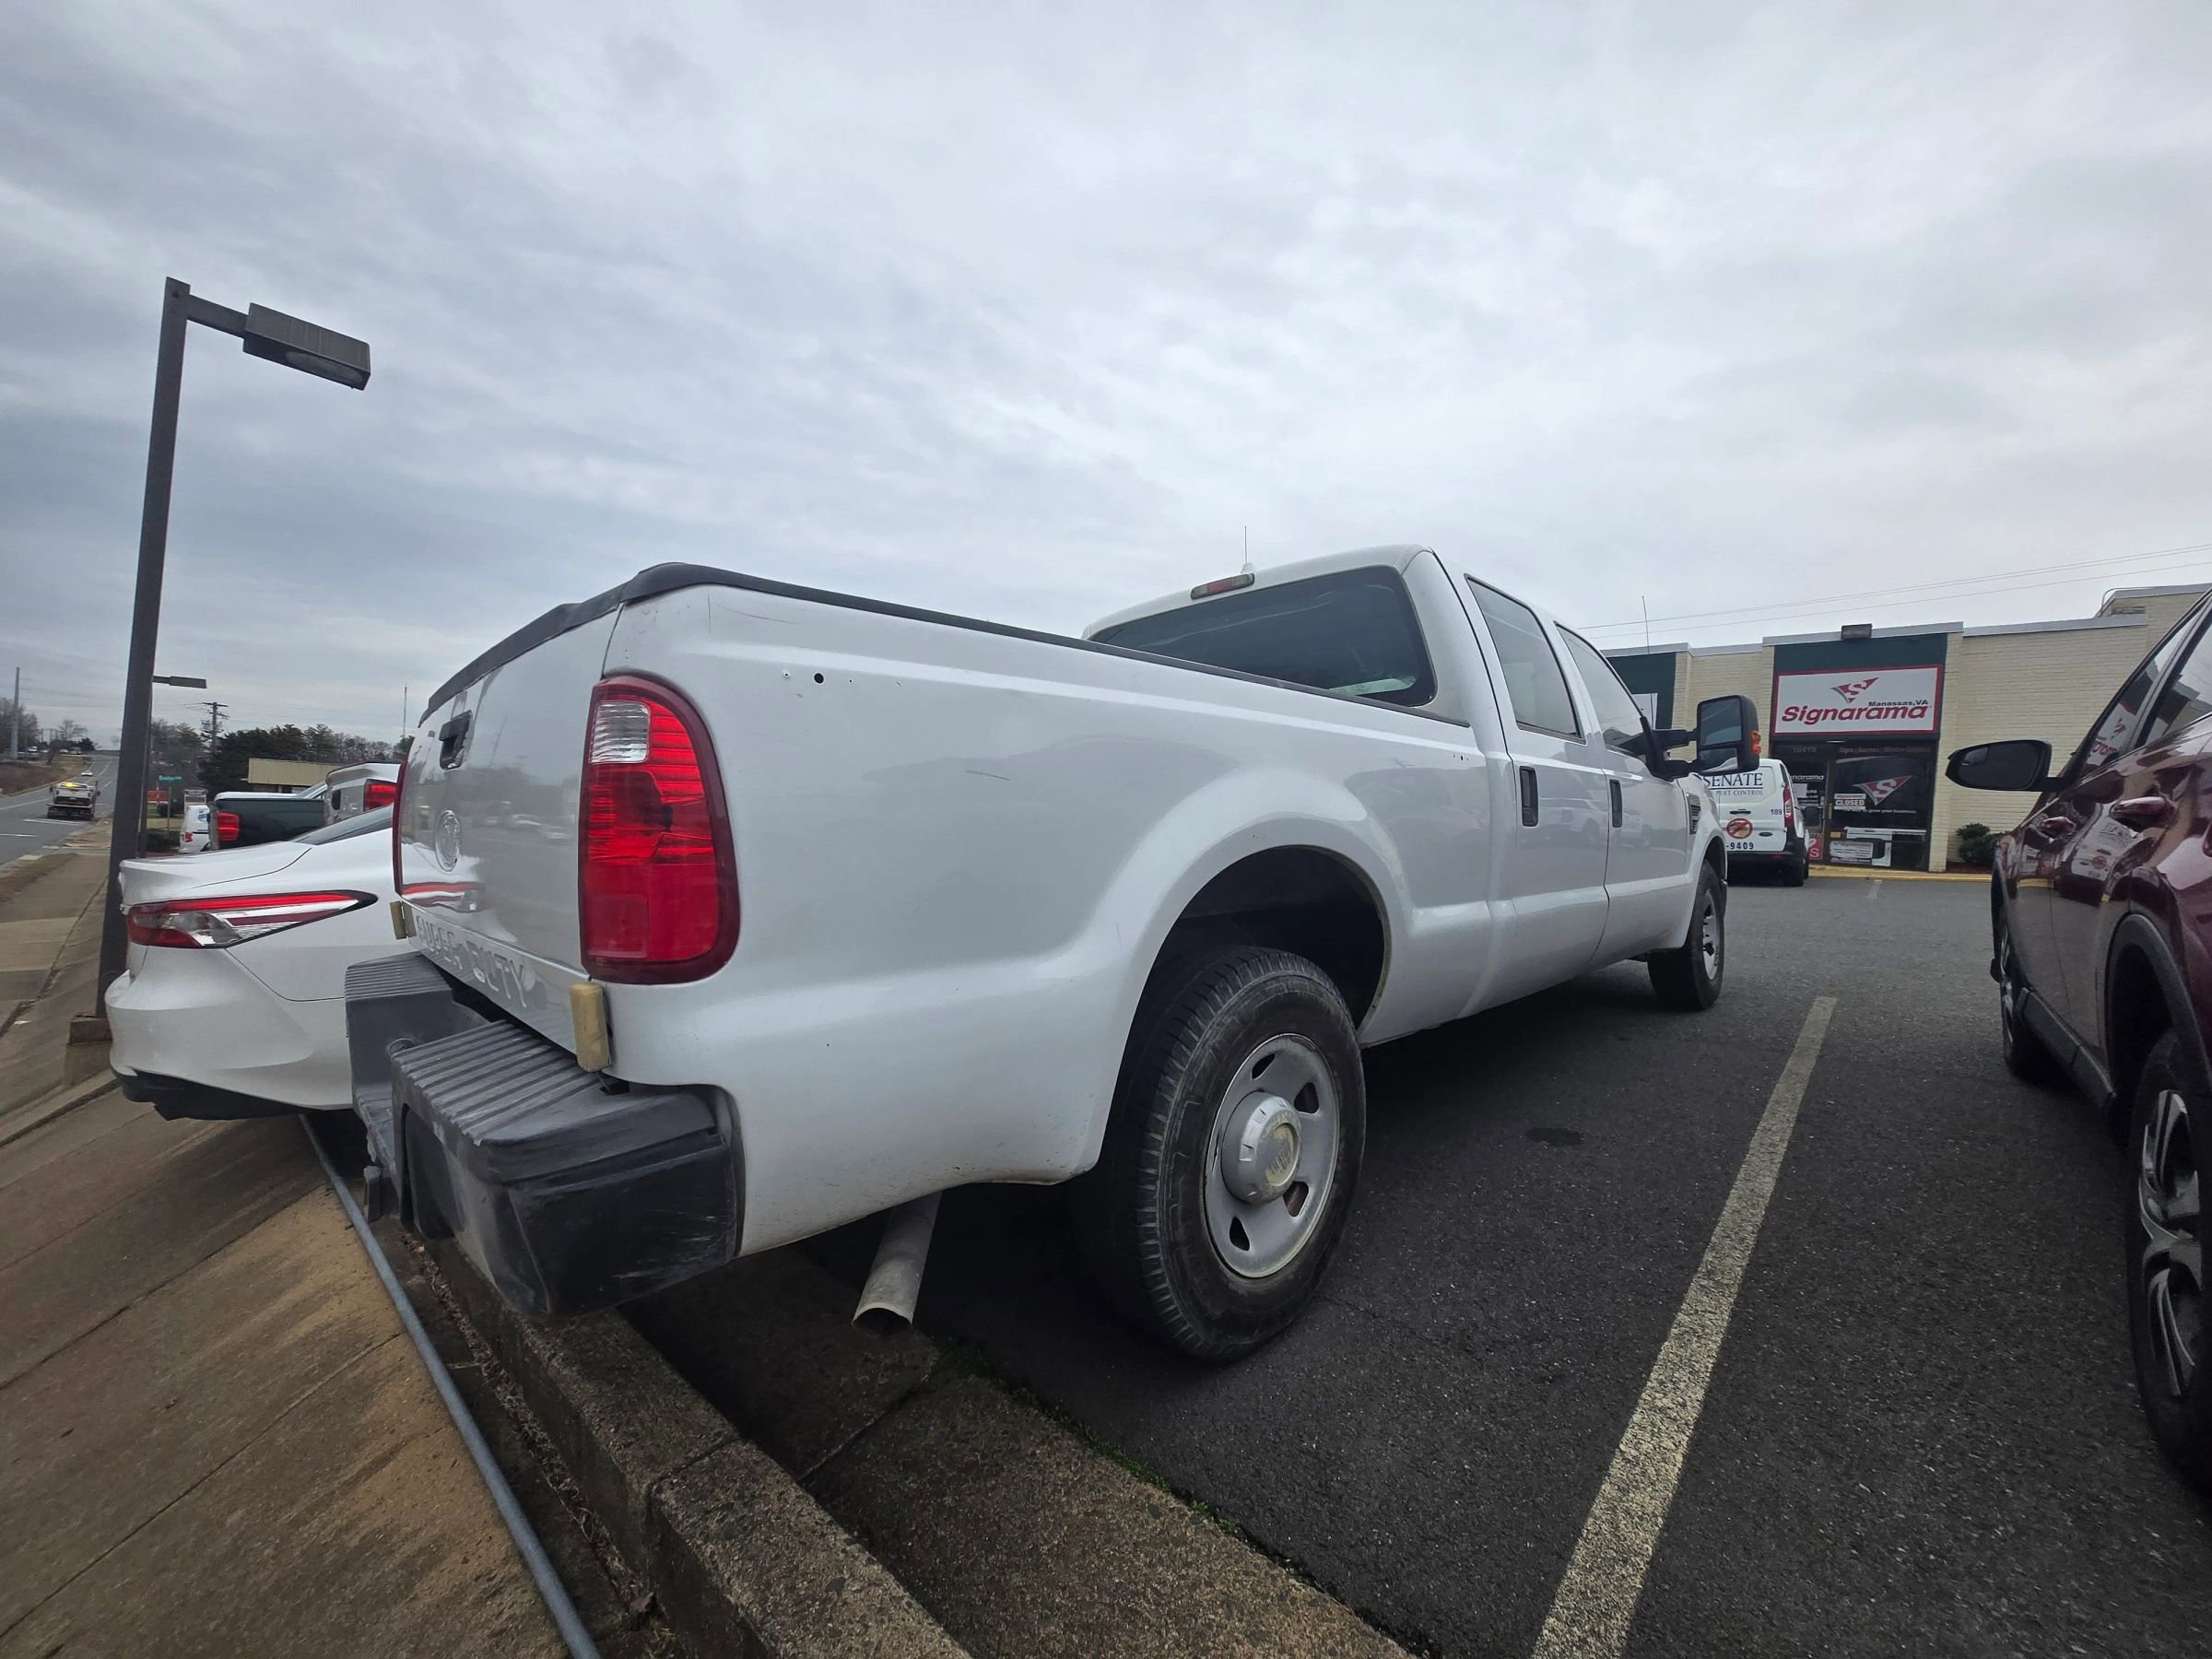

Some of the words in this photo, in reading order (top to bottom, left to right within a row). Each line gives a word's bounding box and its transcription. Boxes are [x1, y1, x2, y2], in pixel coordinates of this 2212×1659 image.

[1782, 705, 1928, 724] Signarama
[1703, 772, 1763, 786] SENATE
[1725, 841, 1754, 850] -9409
